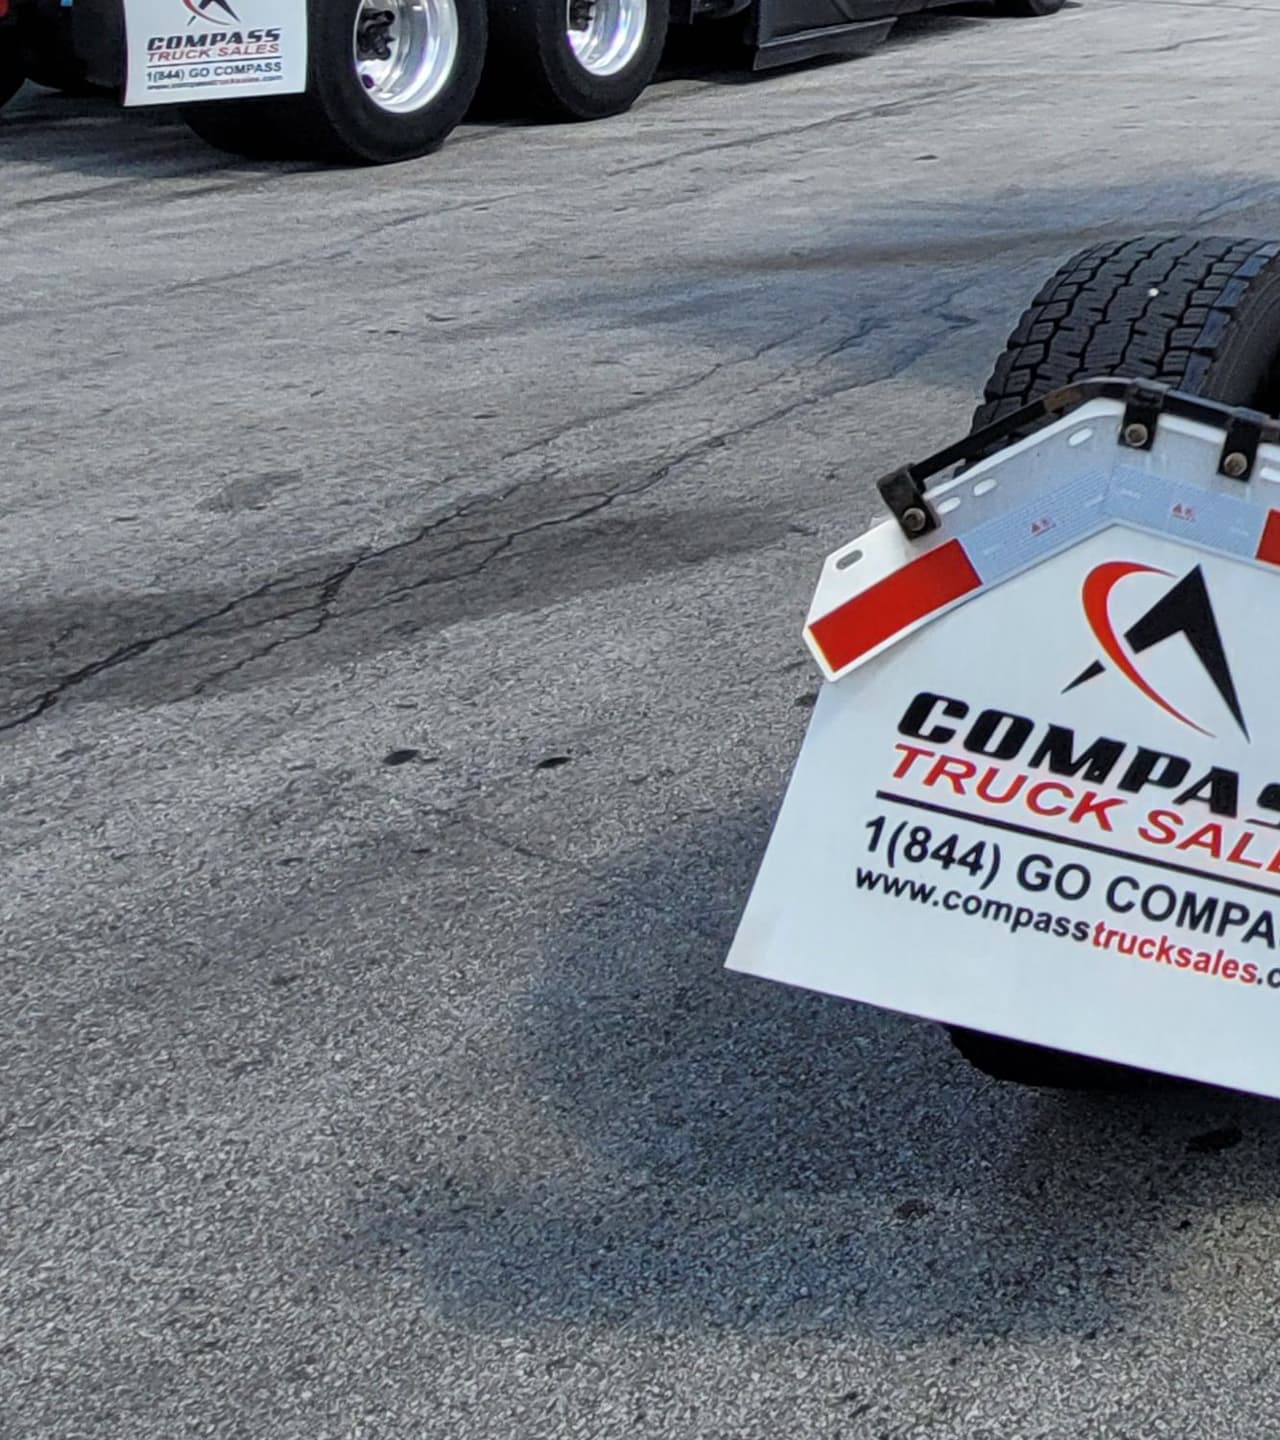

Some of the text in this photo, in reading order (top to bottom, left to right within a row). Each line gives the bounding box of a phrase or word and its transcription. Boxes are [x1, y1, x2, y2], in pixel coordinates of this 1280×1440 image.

[146, 28, 282, 52] COMPASS
[147, 43, 280, 63] TRUCK SALES
[147, 61, 282, 83] 1(844) GO COMPASS
[893, 743, 1127, 832] TRUCK
[866, 816, 1001, 890] 1(844)
[1017, 853, 1091, 901] GO
